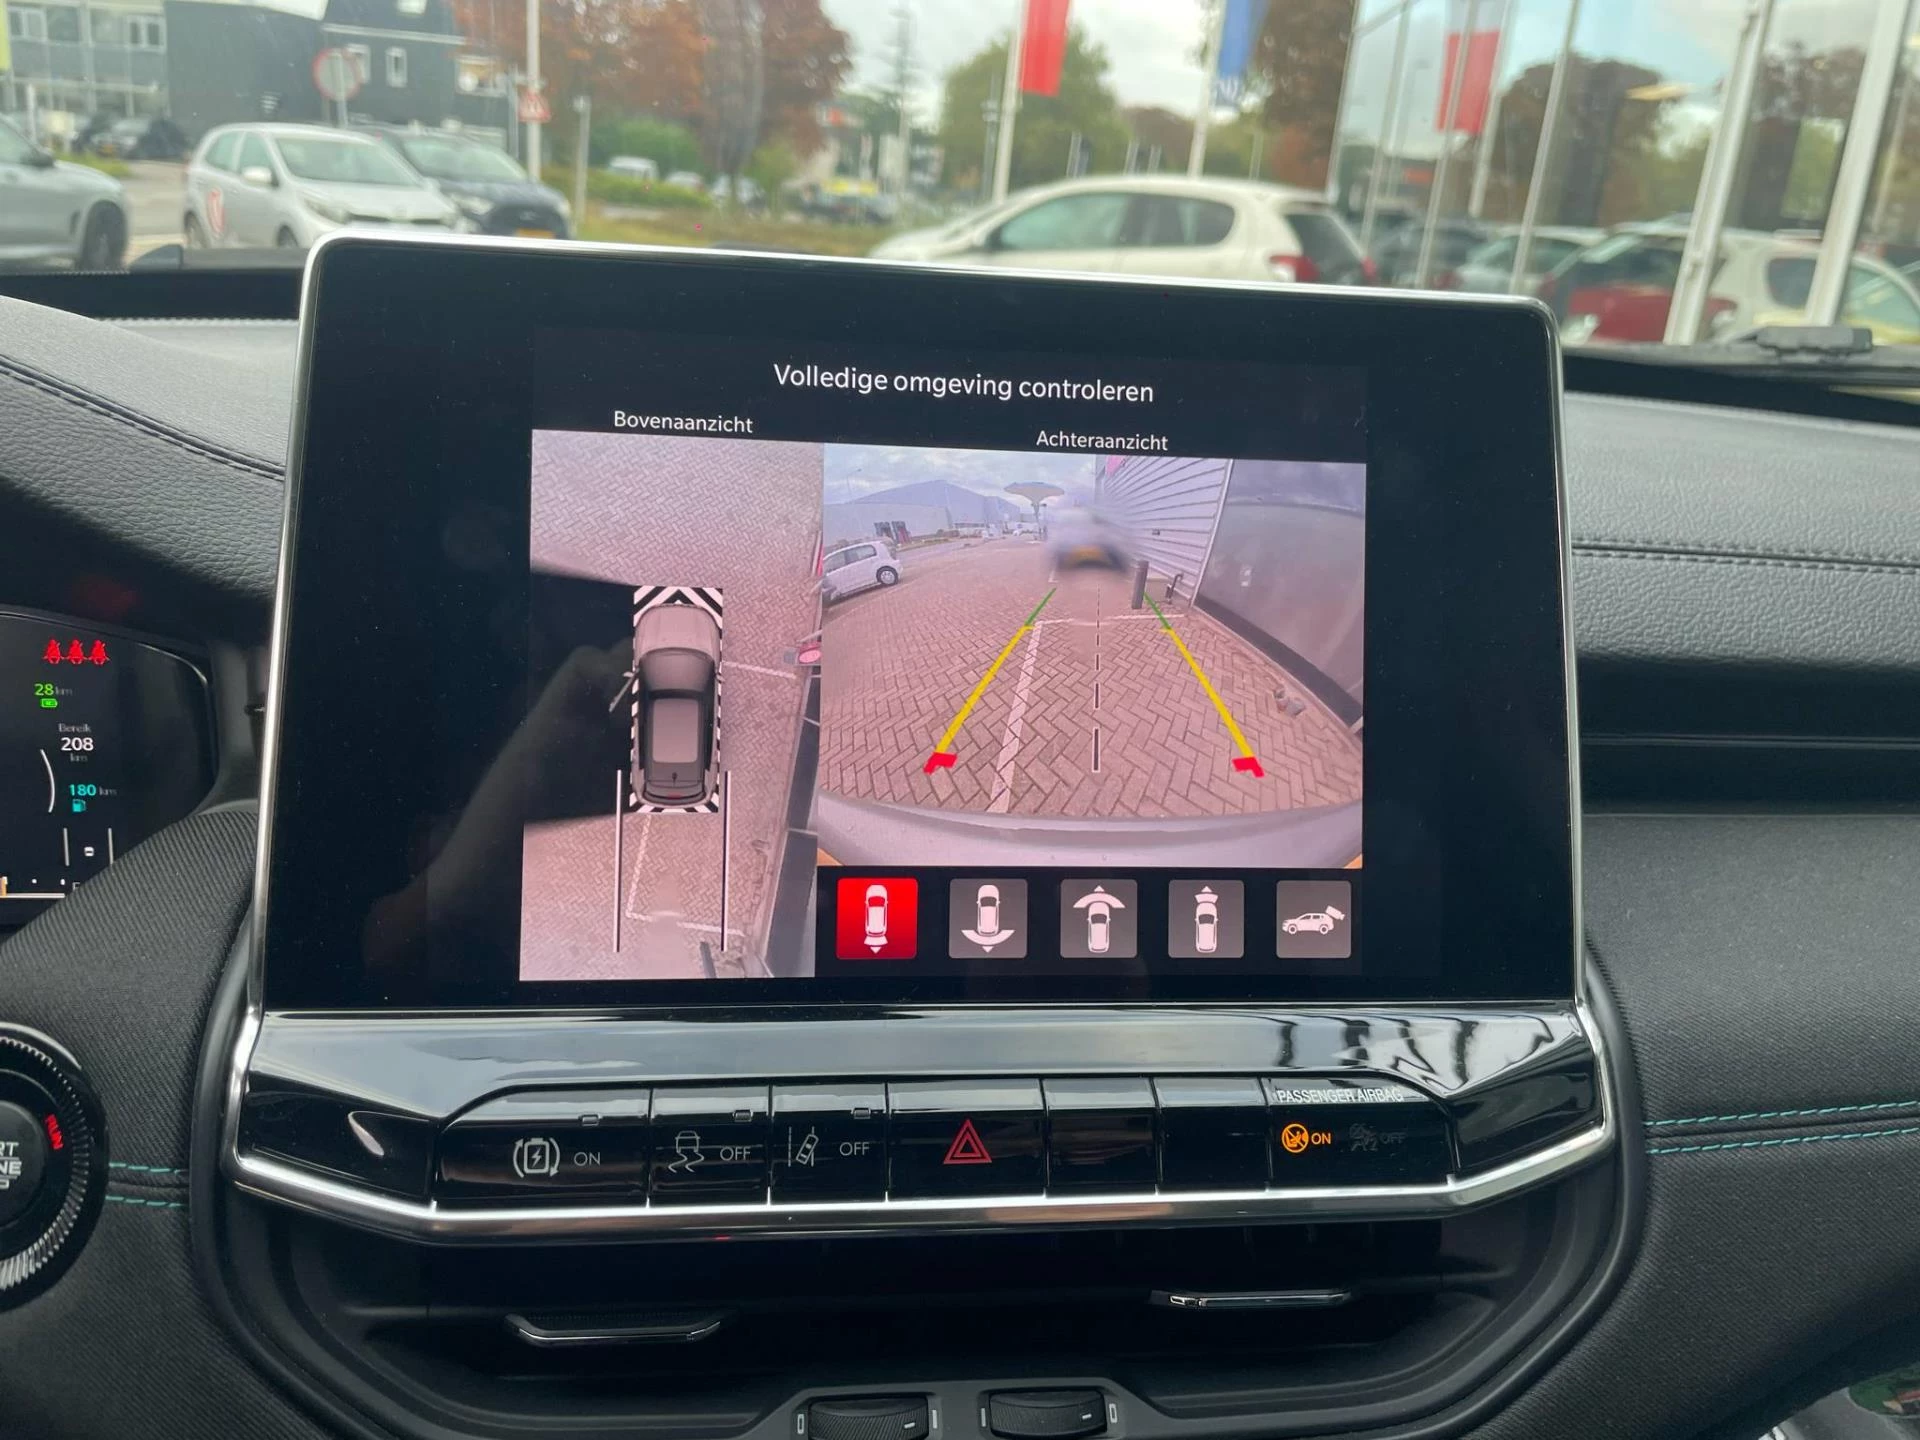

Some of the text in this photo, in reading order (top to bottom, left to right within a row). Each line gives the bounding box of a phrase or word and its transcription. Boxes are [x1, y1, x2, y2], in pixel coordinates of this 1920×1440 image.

[773, 362, 1155, 403] Volledige omgeving controleren
[612, 410, 754, 434] Bovenaanzicht
[1035, 430, 1169, 453] Achteraanzicht
[34, 683, 55, 696] 28
[58, 722, 92, 733] Bereik
[61, 736, 94, 752] 208
[68, 783, 97, 797] 180
[1277, 1088, 1404, 1103] PASSENGER AIRBAG
[1311, 1132, 1332, 1145] ON
[1380, 1132, 1407, 1145] OFF
[719, 1146, 751, 1161] OFF
[839, 1141, 870, 1156] OFF
[573, 1152, 601, 1167] ON
